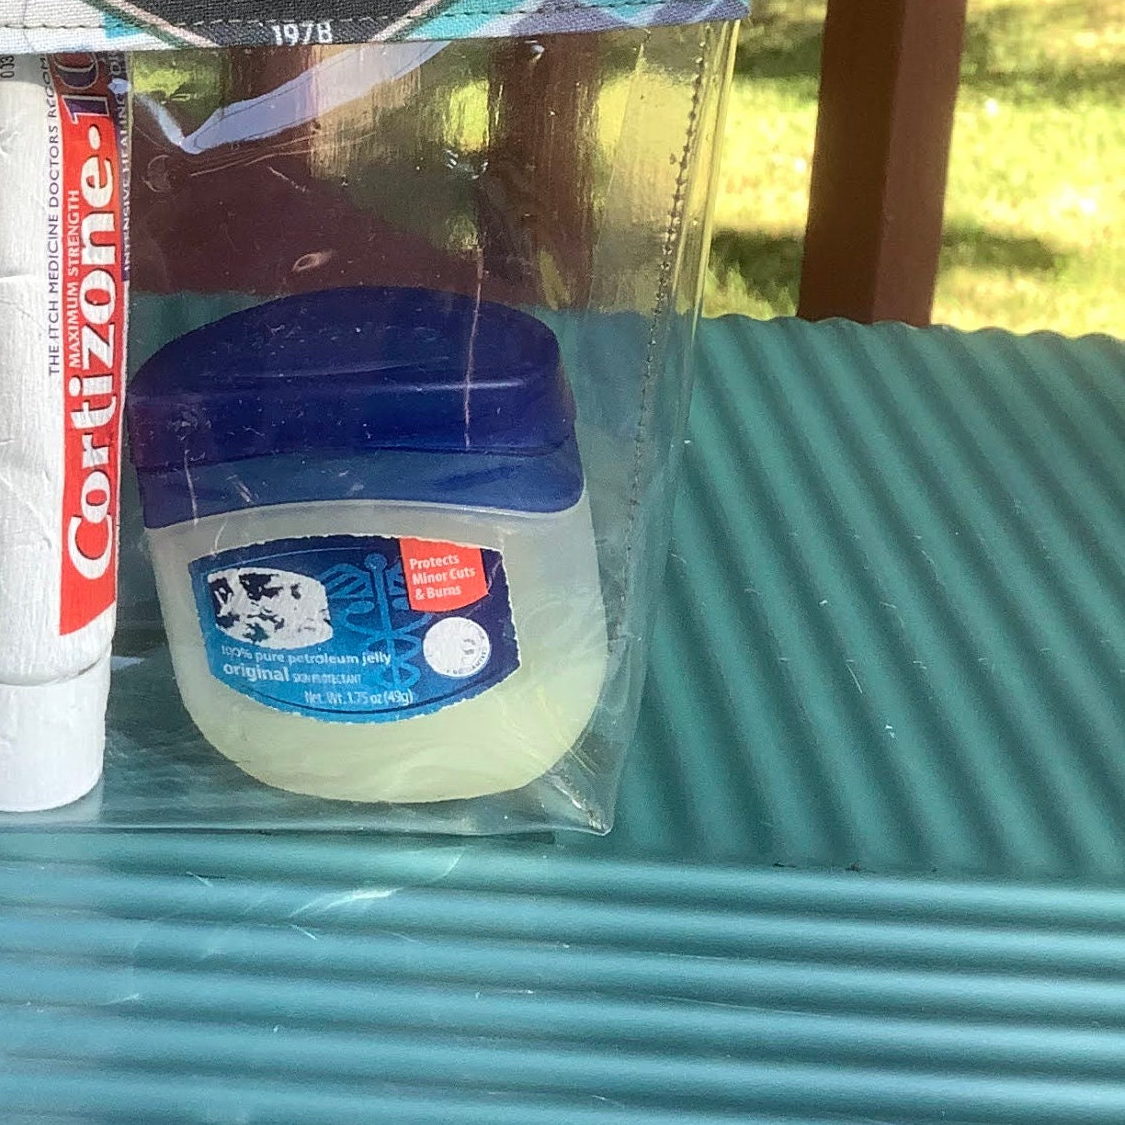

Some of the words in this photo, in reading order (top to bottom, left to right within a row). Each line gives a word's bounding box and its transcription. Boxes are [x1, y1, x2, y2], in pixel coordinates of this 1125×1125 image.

[271, 21, 333, 46] 1978
[48, 125, 60, 208] DOCTORS
[67, 190, 81, 277] STRENGTH
[47, 216, 60, 294] MEDICINE
[48, 301, 60, 340] ITCH
[67, 281, 81, 368] MAXIMUM
[48, 344, 60, 376] THE
[409, 555, 460, 569] Protects
[412, 571, 449, 585] Minor
[449, 567, 476, 580] Cuts
[415, 587, 425, 601] &
[426, 585, 462, 599] Burns
[255, 652, 285, 665] pure
[288, 652, 359, 665] petroleum
[362, 651, 392, 667] jelly
[223, 662, 290, 683] original
[369, 693, 382, 704] oz
